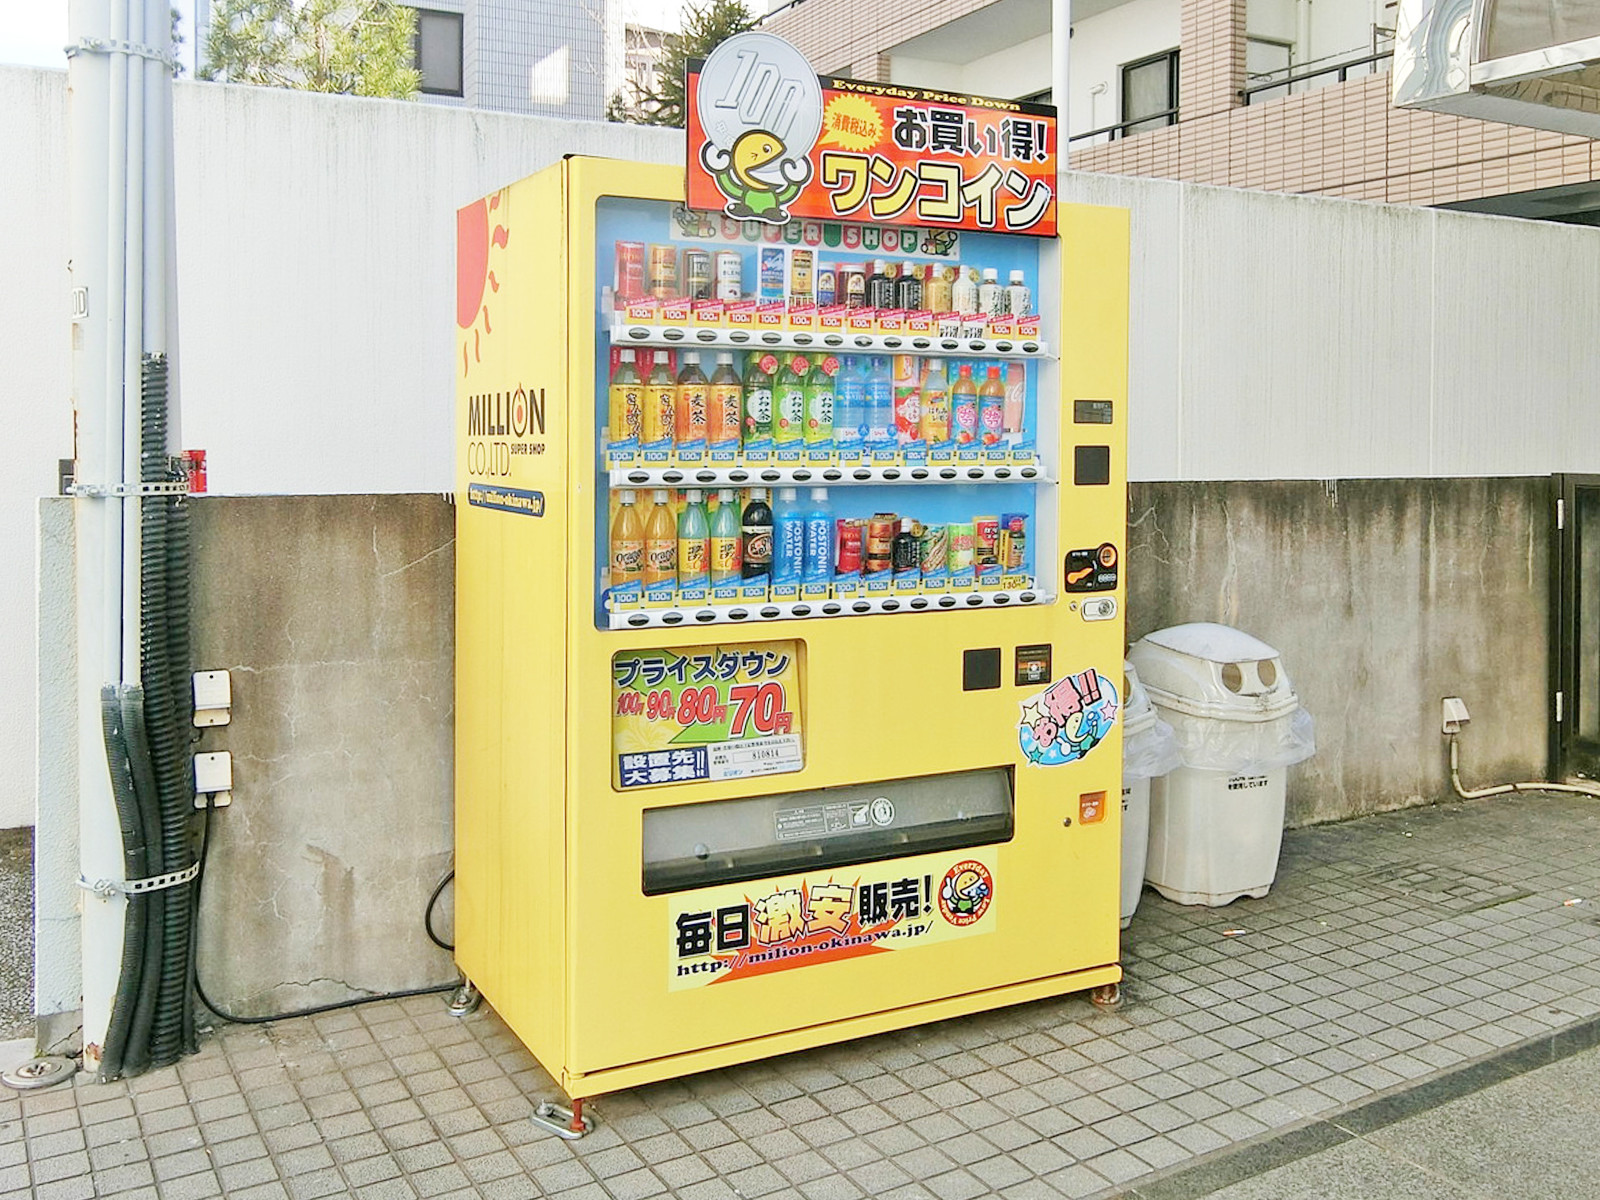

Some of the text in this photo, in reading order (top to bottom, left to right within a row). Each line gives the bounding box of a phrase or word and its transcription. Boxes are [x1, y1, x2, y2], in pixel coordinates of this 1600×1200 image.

[832, 79, 1021, 112] Everyday Price Down
[831, 112, 877, 138] 消費税込み
[893, 107, 1048, 161] お買い得!
[822, 152, 1050, 229] ワンコイン
[722, 220, 915, 253] SUPER SHOP
[468, 388, 545, 437] MILLION
[690, 394, 706, 425] 麦茶
[758, 396, 770, 421] お茶
[791, 396, 803, 422] お茶
[821, 397, 833, 423] お茶
[511, 444, 545, 455] SUPER SHOP
[615, 651, 789, 686] プライスダウン
[677, 685, 727, 724] 80円
[729, 682, 793, 735] 70円
[676, 874, 934, 958] 毎日激安販売!
[676, 920, 934, 977] http://milion-okinawa.jp/
